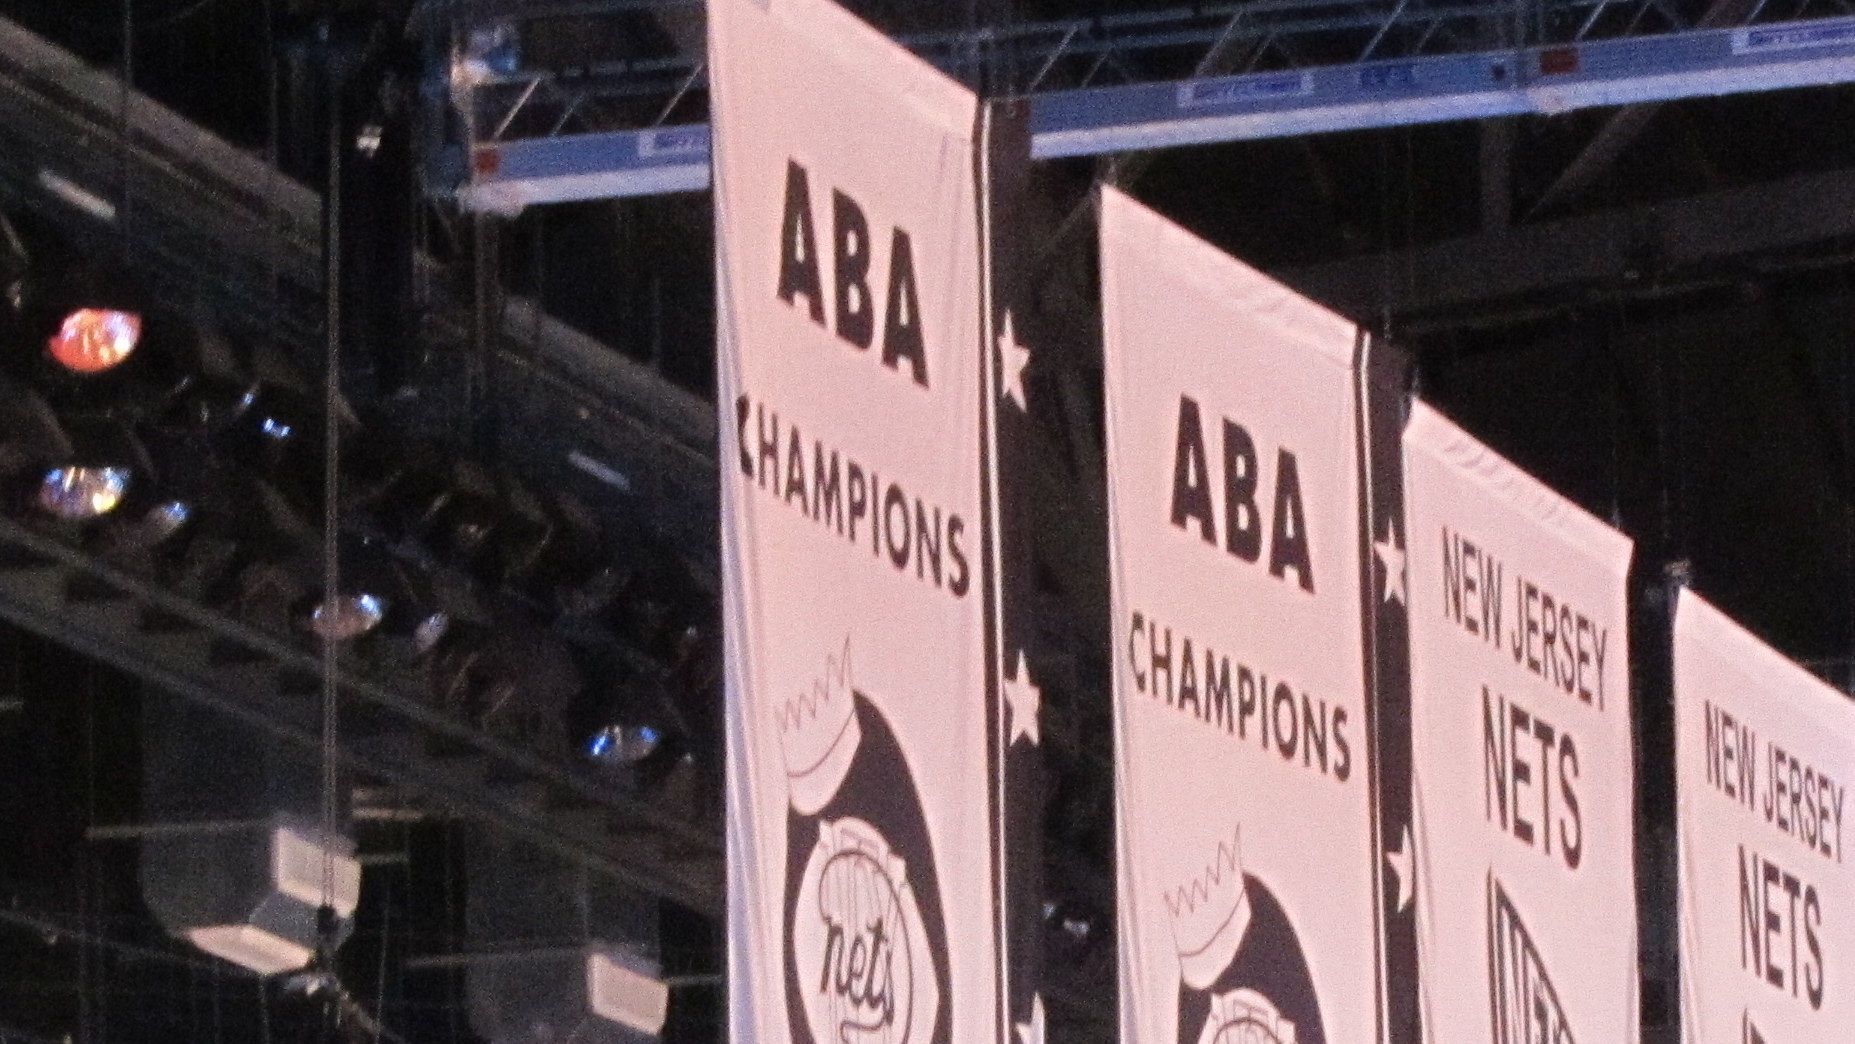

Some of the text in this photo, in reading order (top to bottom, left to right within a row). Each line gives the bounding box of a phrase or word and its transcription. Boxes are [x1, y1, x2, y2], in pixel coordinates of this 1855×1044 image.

[778, 156, 930, 390] ABA
[735, 393, 970, 598] CHAMPIONS
[1171, 392, 1315, 594] ABA
[1129, 610, 1351, 783] CHAMPIONS
[1442, 525, 1607, 712] NEW JERSEY
[1482, 684, 1583, 870] NETS
[1705, 699, 1843, 864] NEW JERSEY
[1738, 843, 1824, 1012] NETS
